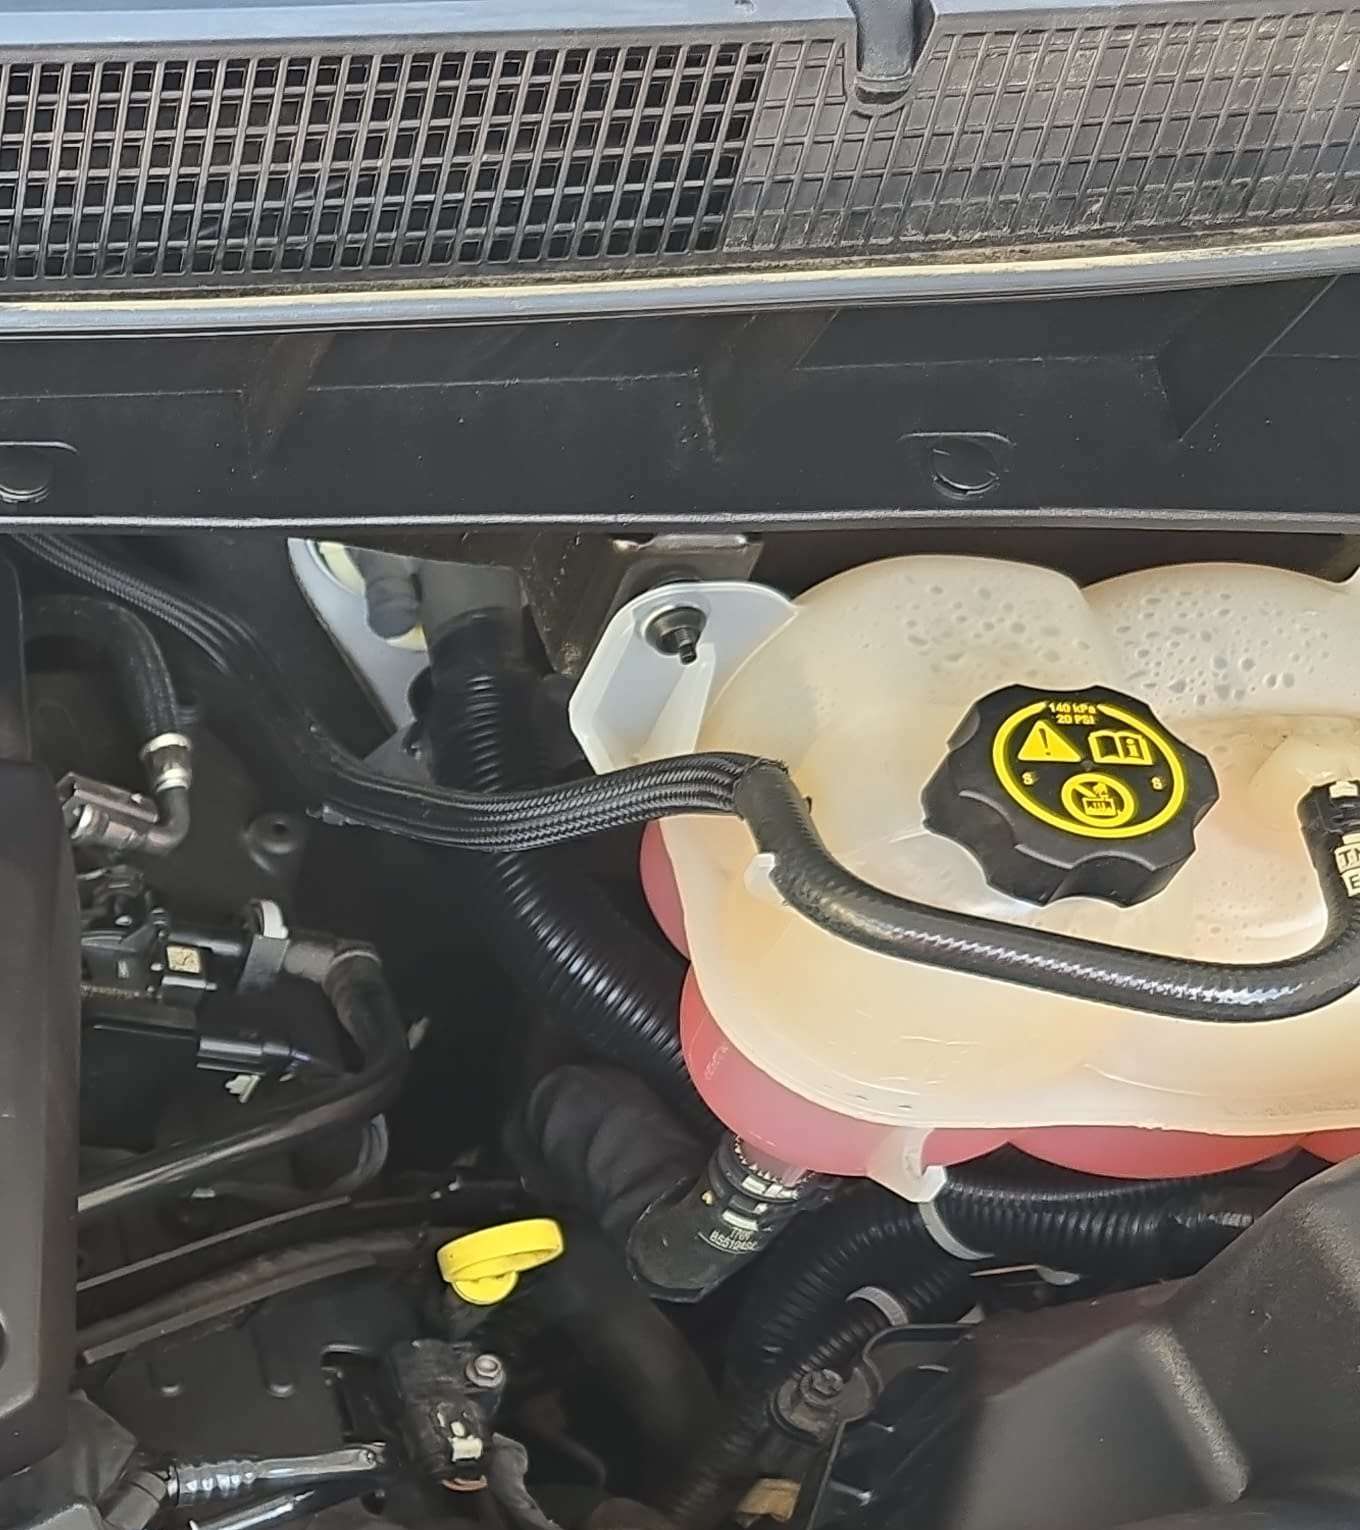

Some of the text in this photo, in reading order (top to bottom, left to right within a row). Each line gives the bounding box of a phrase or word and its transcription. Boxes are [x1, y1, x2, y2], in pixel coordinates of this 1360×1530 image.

[1048, 702, 1096, 714] 140 kPa
[1056, 714, 1096, 725] 20 PSI
